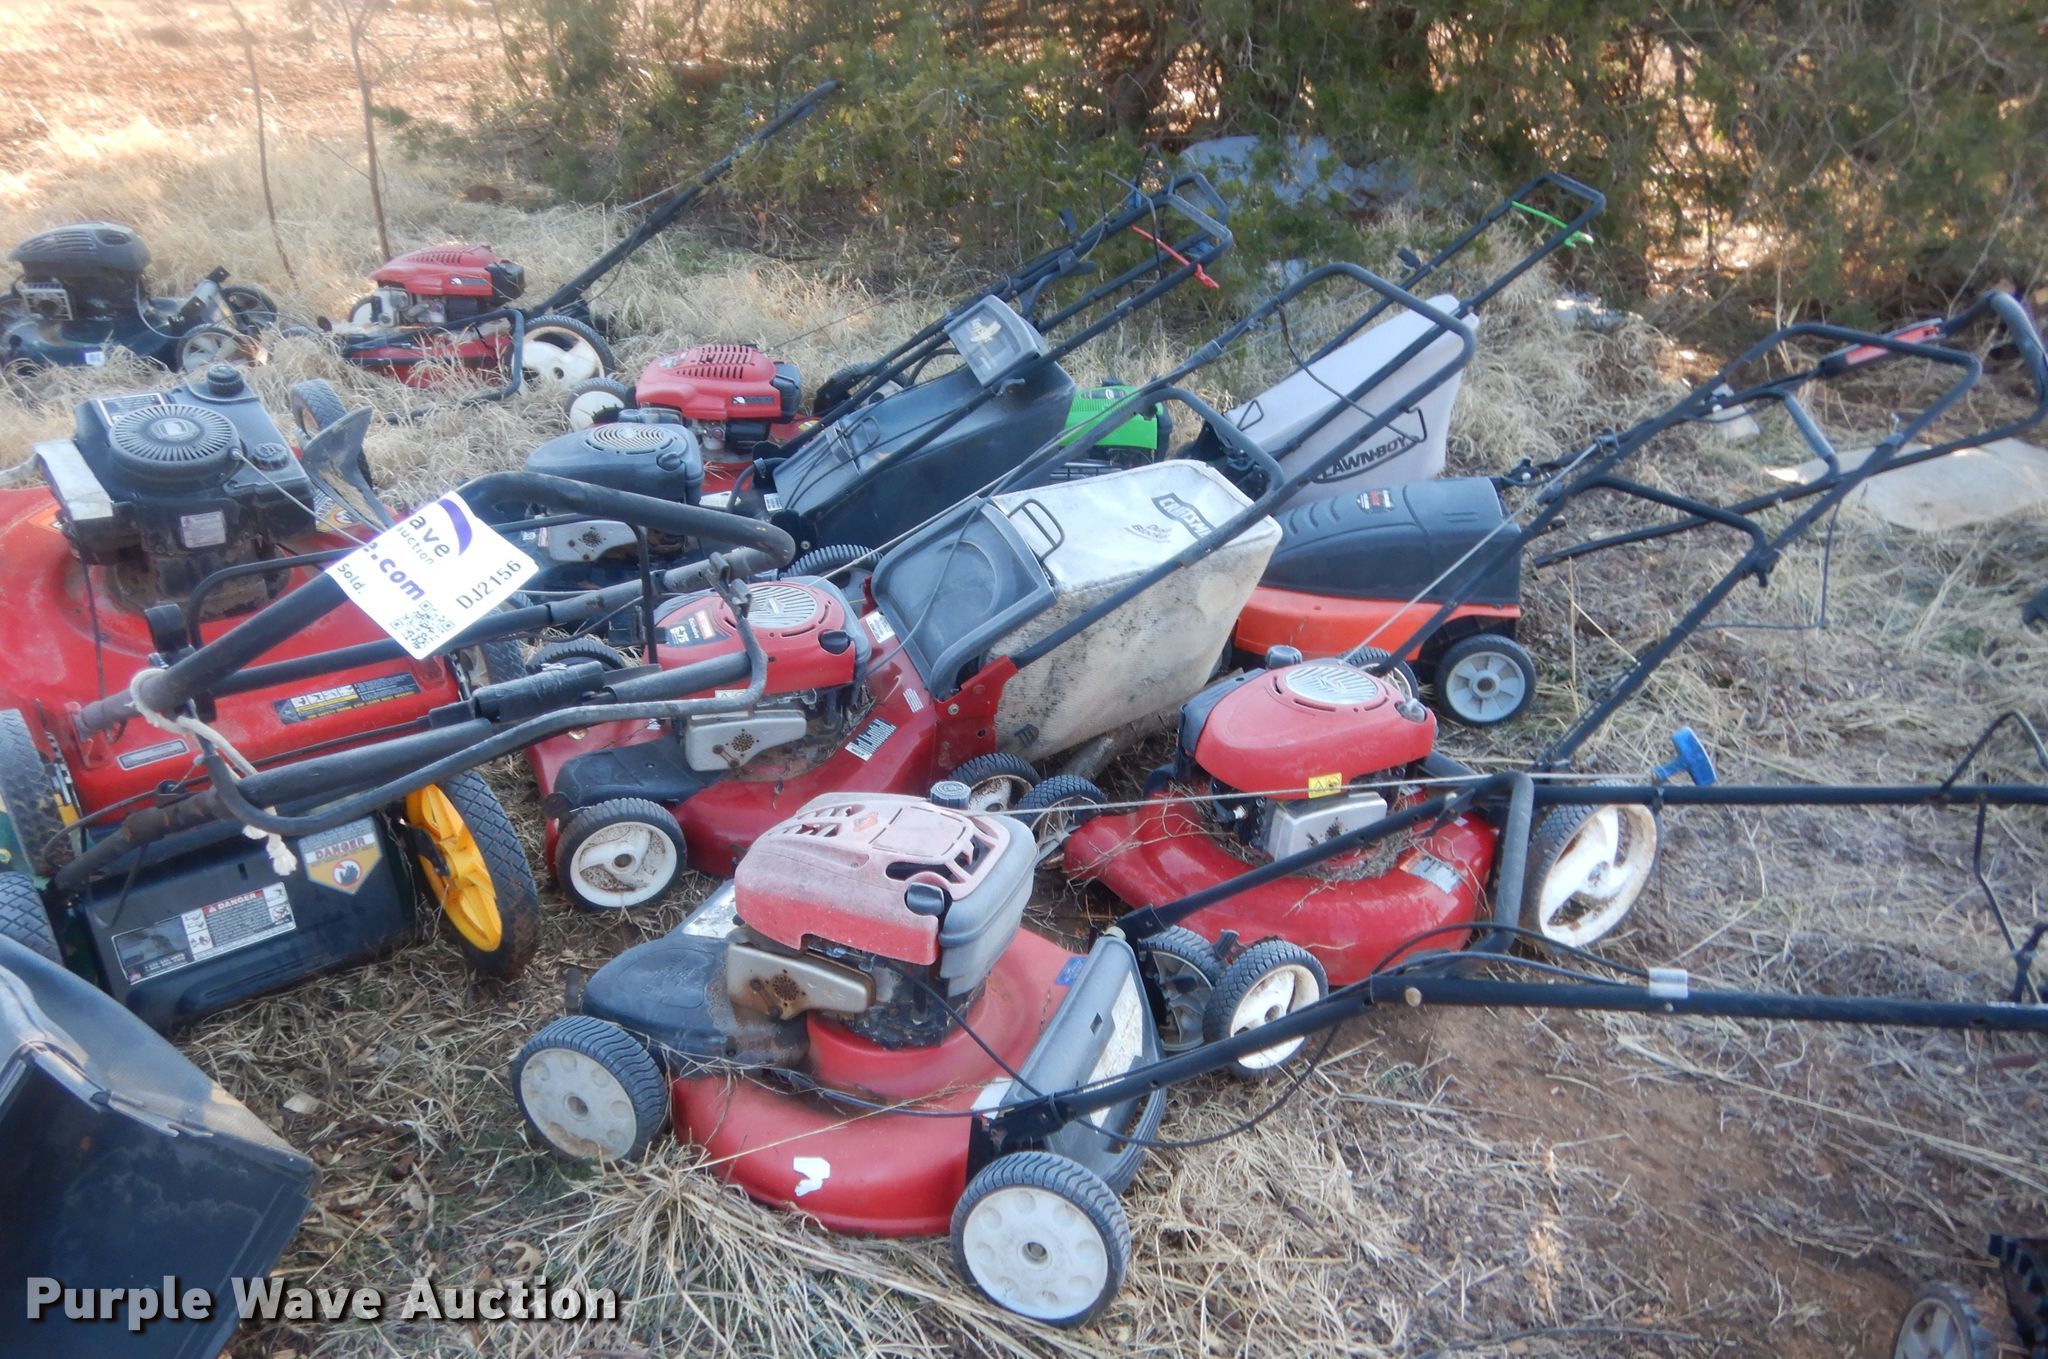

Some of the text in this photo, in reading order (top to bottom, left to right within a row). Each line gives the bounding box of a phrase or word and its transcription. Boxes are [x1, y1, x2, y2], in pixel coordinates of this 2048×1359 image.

[397, 526, 434, 565] uction
[408, 515, 451, 558] ave
[337, 562, 366, 595] Sold.
[455, 560, 521, 610] DJ2156
[314, 836, 366, 860] DANGER
[217, 893, 257, 910] DANGER
